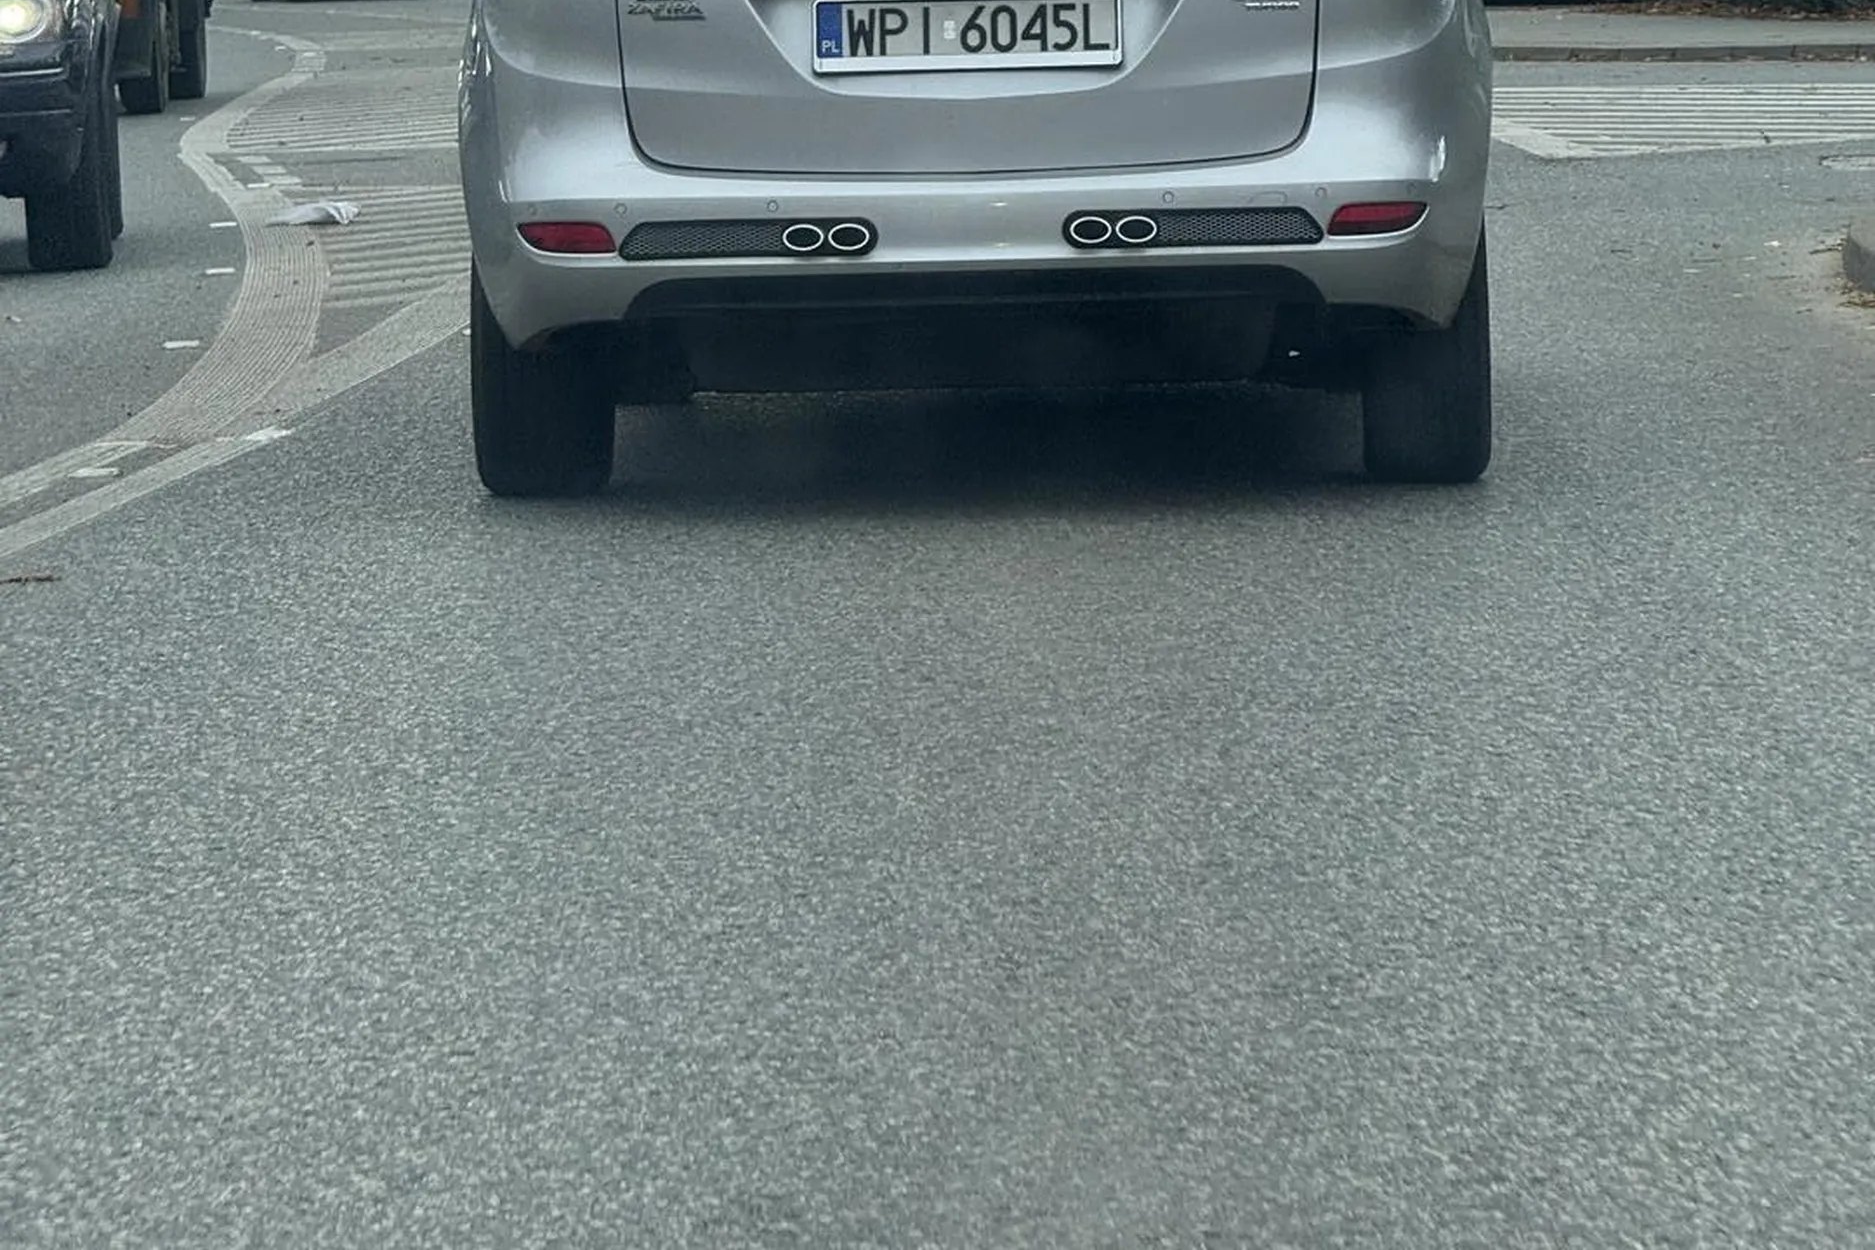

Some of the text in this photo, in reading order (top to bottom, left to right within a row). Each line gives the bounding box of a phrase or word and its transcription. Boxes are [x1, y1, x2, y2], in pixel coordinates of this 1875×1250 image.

[821, 39, 839, 53] PL
[847, 2, 1110, 57] WPI 6045L
